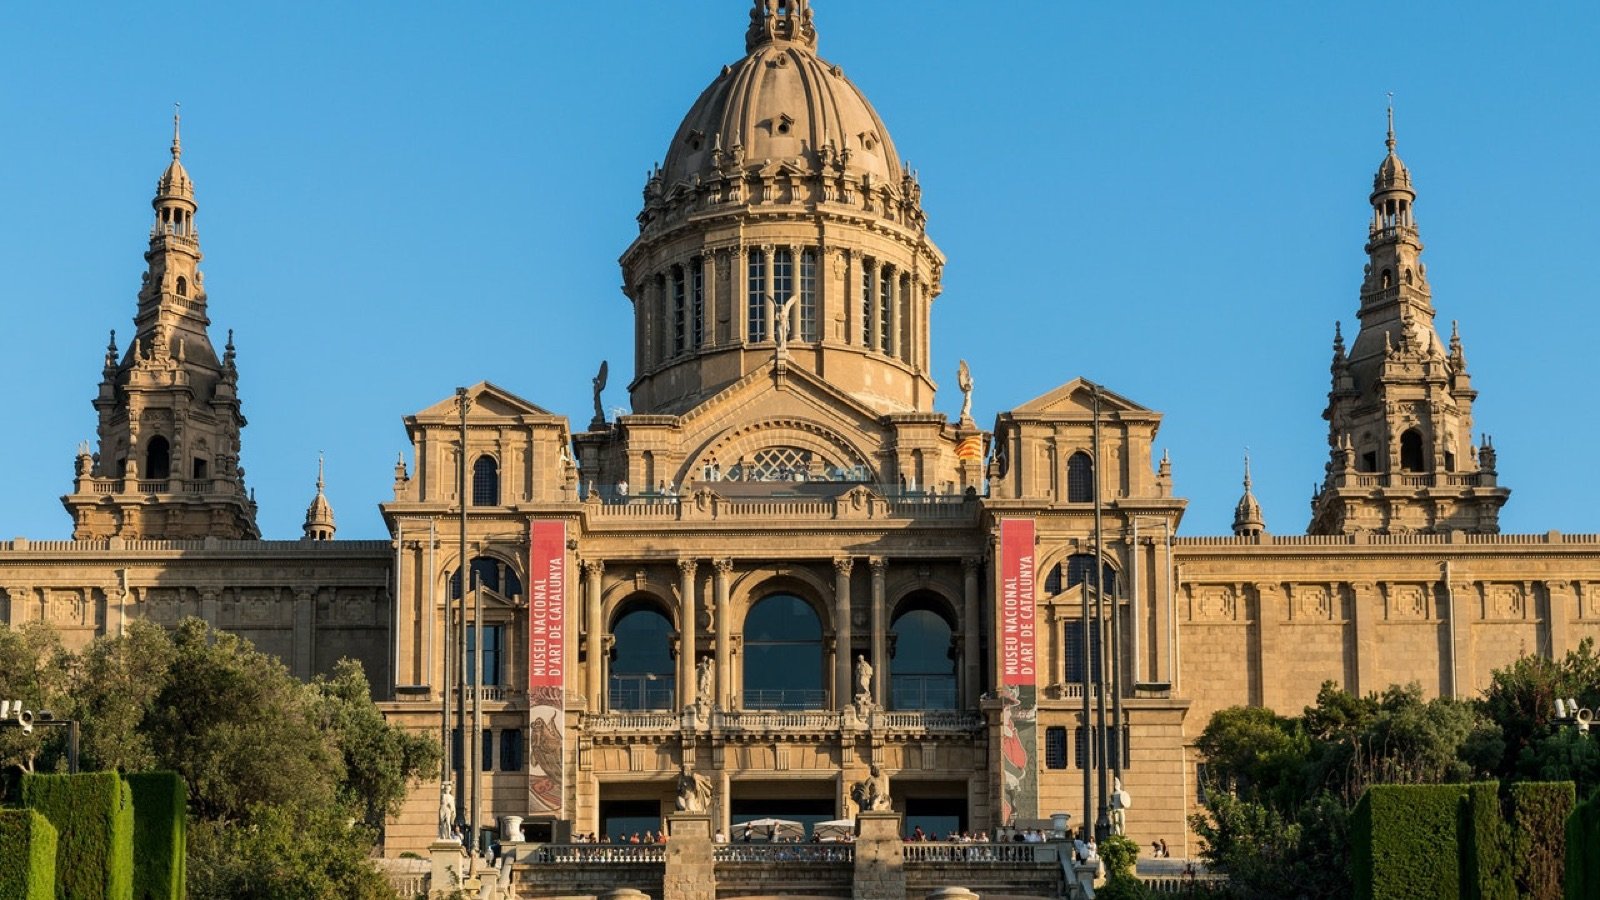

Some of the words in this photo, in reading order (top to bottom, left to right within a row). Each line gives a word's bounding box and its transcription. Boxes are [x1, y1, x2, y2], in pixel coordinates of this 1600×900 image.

[534, 578, 546, 634] NACIONAL
[549, 558, 562, 620] CATALUNYA
[1005, 577, 1018, 632] NACIONAL
[1020, 556, 1032, 619] CATALUNYA
[549, 625, 561, 639] DE
[1020, 623, 1033, 637] DE
[534, 639, 546, 676] MUSEU
[549, 644, 561, 676] D'ART
[1005, 637, 1018, 675] MUSEU
[1020, 642, 1033, 675] D'ART
